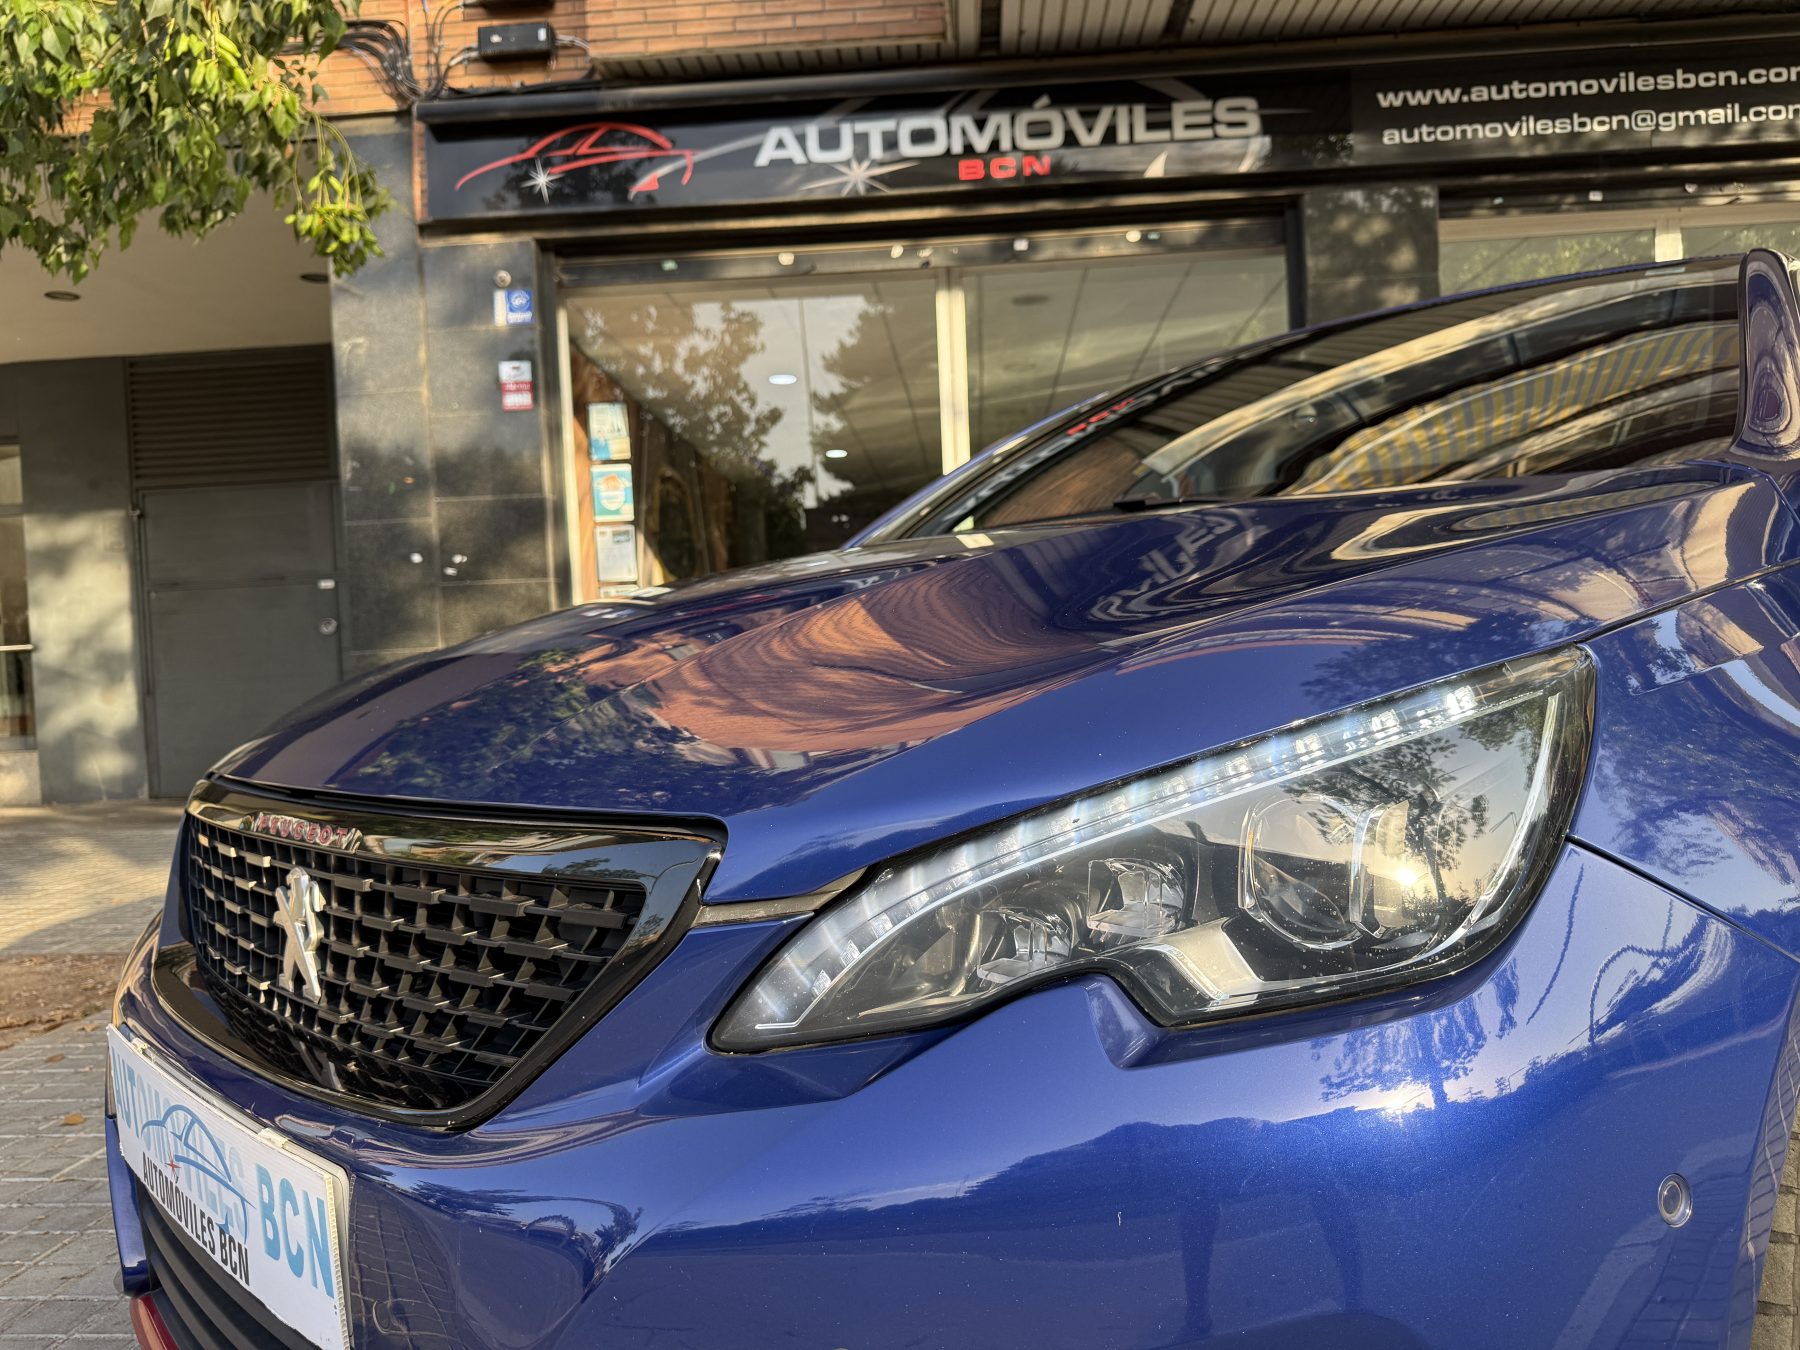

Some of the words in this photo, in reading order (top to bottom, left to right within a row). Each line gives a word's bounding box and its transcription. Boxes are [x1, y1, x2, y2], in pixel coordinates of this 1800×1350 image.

[754, 95, 1261, 167] AUTOMÓVILES
[958, 154, 1051, 181] BCN
[142, 1151, 216, 1256] AUTOMÓVILES
[218, 1223, 251, 1287] BCN
[255, 1162, 335, 1299] BCN
